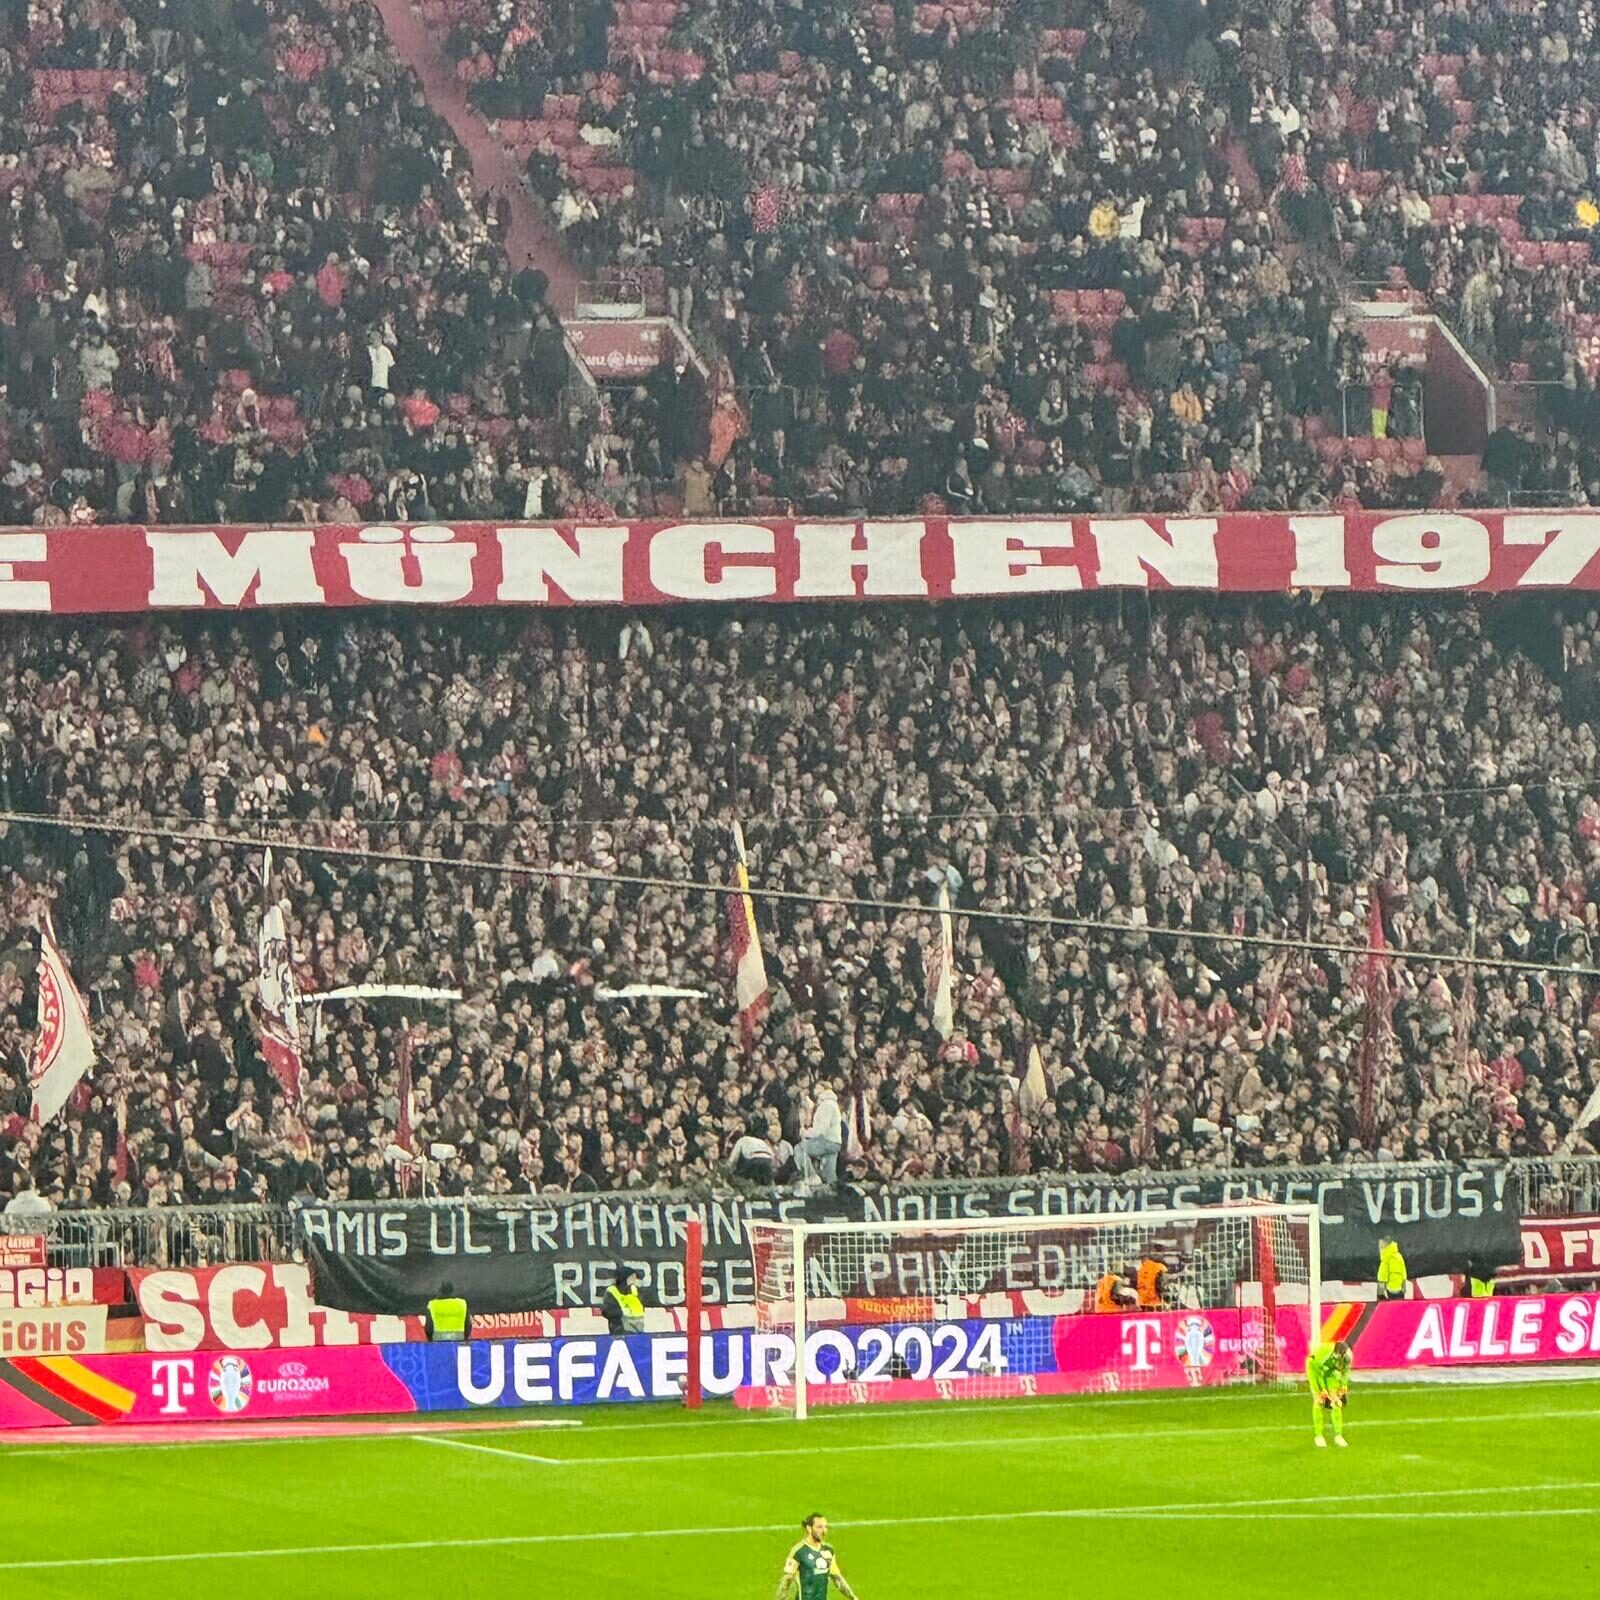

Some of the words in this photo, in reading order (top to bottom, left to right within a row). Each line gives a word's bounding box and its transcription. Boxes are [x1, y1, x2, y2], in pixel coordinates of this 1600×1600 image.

[146, 517, 1219, 606] MÜNCHEN
[303, 1208, 408, 1256] AMIS
[1008, 1184, 1200, 1228] SOMMES
[1362, 1171, 1503, 1225] VOUS!
[470, 1310, 543, 1329] SSISMUS
[1406, 1298, 1546, 1361] ALLE
